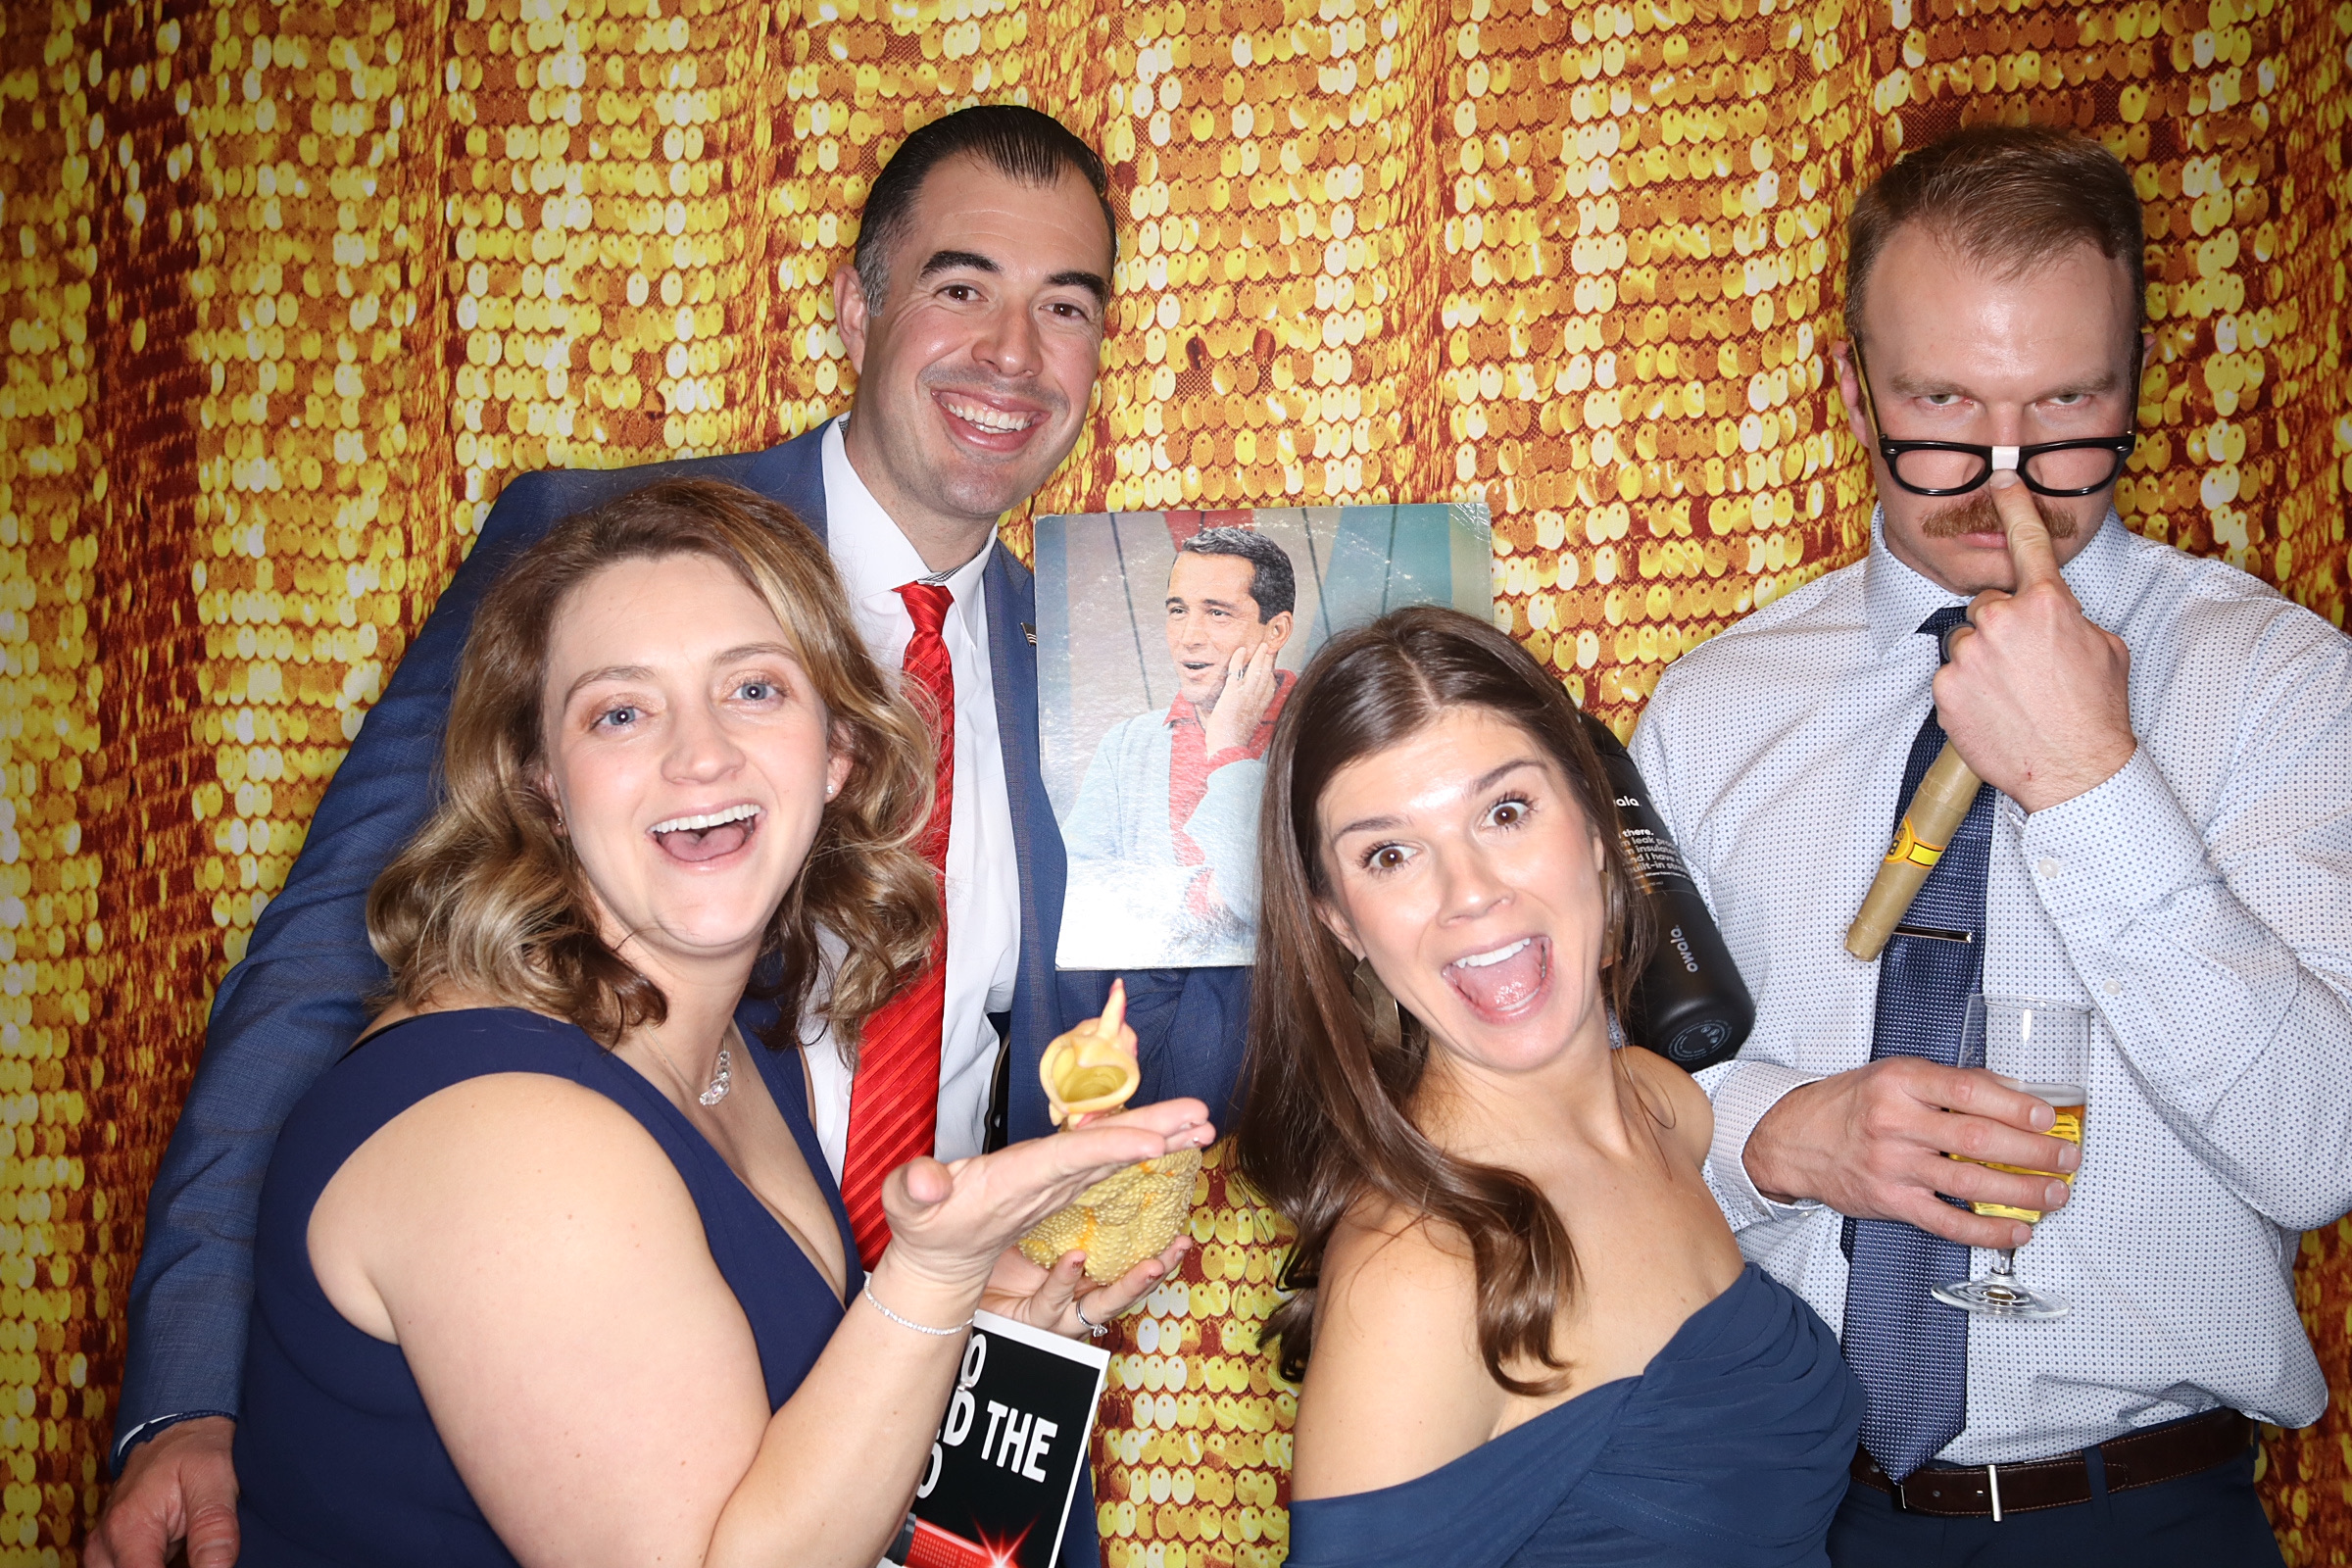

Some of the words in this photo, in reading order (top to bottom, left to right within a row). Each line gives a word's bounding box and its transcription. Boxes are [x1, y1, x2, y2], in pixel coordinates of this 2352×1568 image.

[1613, 795, 1641, 808] ala
[1622, 828, 1654, 837] there.
[1631, 836, 1655, 845] leak
[937, 1387, 976, 1447] D
[981, 1399, 1058, 1484] THE
